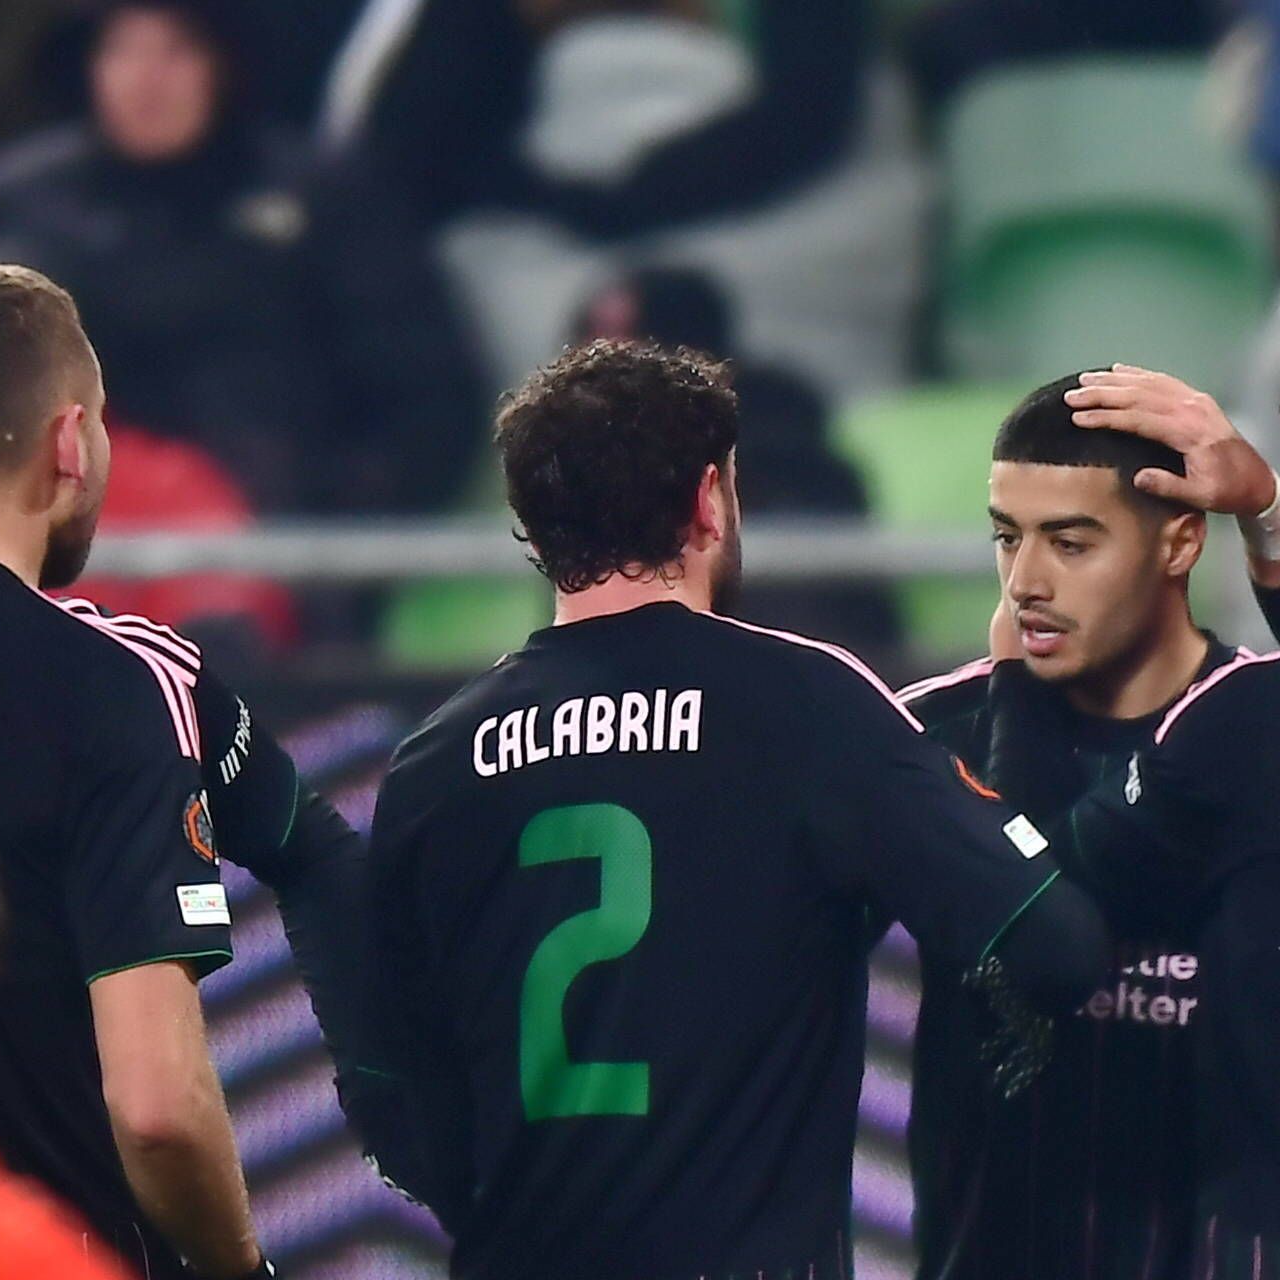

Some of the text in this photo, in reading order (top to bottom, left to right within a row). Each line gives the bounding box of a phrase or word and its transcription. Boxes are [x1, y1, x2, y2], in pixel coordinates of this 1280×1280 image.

[473, 689, 702, 777] CALABRIA
[519, 803, 652, 1122] 2
[1075, 982, 1198, 1026] elter
